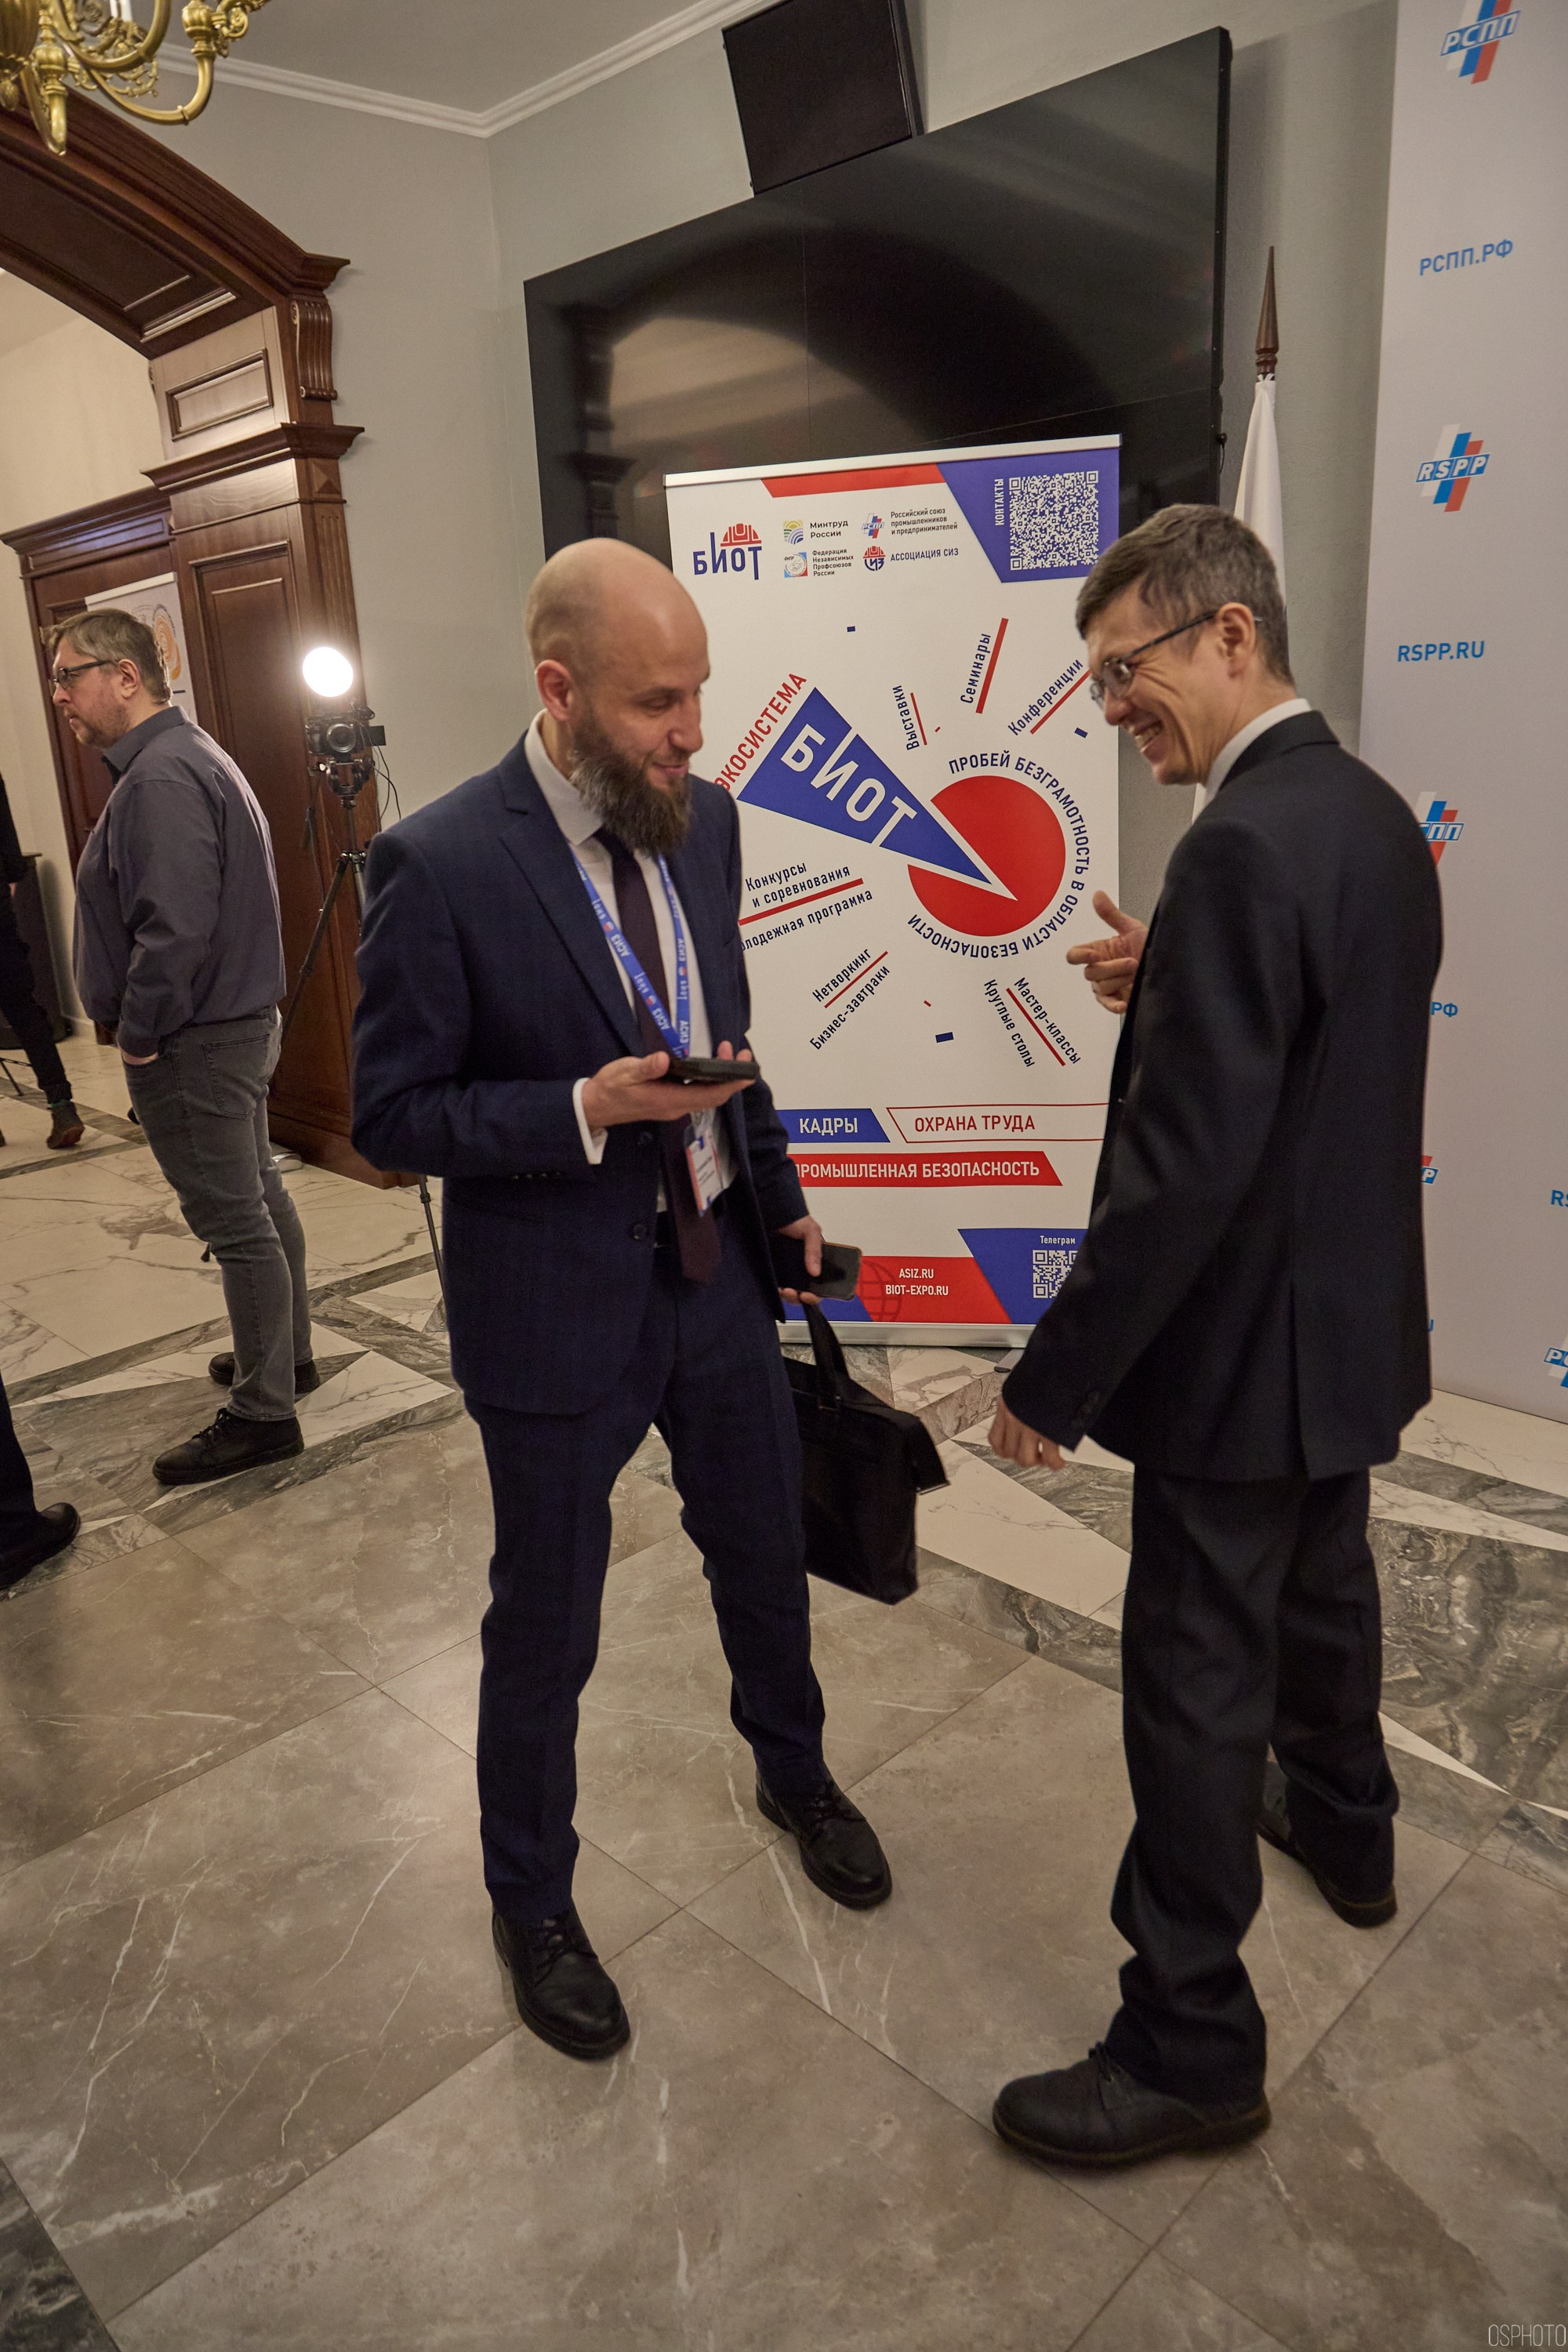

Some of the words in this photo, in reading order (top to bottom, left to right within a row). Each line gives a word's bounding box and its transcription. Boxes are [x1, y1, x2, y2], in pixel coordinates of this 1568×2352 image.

[1443, 12, 1519, 54] РСПП
[1420, 239, 1513, 276] РСПП.РФ
[1417, 456, 1487, 481] RSPP
[891, 508, 928, 518] Российский
[994, 478, 1004, 526] КОНТАКТЫ
[810, 520, 848, 530] Минтруд
[810, 530, 842, 539] России
[891, 517, 947, 527] промышленников
[896, 522, 958, 535] предпринимателей
[693, 532, 762, 580] БИОТ
[812, 554, 854, 563] Независимых
[813, 561, 852, 570] Профсоюзов
[891, 549, 941, 561] АССОЦИАЦИЯ
[943, 548, 959, 557] СИЗ
[1397, 641, 1485, 662] RSPP.RU
[960, 633, 991, 703] Семинары
[1007, 659, 1083, 735] Конференции
[892, 685, 920, 750] Выставки
[714, 673, 807, 791] ЭКОСИСТЕМА
[949, 750, 1011, 774] ПРОБЕЙ
[780, 724, 917, 846] БИОТ
[1014, 757, 1090, 875] БЕЗГРАМОТНОСТЬ
[1419, 823, 1463, 840] ПП
[746, 863, 807, 891] Конкурсы
[752, 898, 760, 908] и
[764, 866, 850, 904] соревнования
[1071, 880, 1085, 891] В
[740, 917, 804, 951] олодежная
[808, 890, 873, 924] программа
[1022, 894, 1078, 951] ОБЛАСТИ
[907, 914, 1019, 959] БЕЗОПАСНОСТИ
[812, 949, 871, 1002] Нетворкинг
[809, 965, 890, 1050] Бизнес-завтраки
[1014, 977, 1081, 1064] Мастер-классы
[984, 979, 1015, 1030] Круглые
[1011, 1033, 1035, 1067] столы
[800, 1117, 858, 1135] КАДРЫ
[915, 1116, 977, 1132] ОХРАНА
[982, 1115, 1035, 1132] ТРУДА
[922, 1161, 1040, 1178] БЕЗОПАСНОСТЬ
[1040, 1236, 1076, 1246] Телеграм
[899, 1269, 934, 1279] ASIZ.RU
[885, 1285, 949, 1295] BIOT-EXPO.RU
